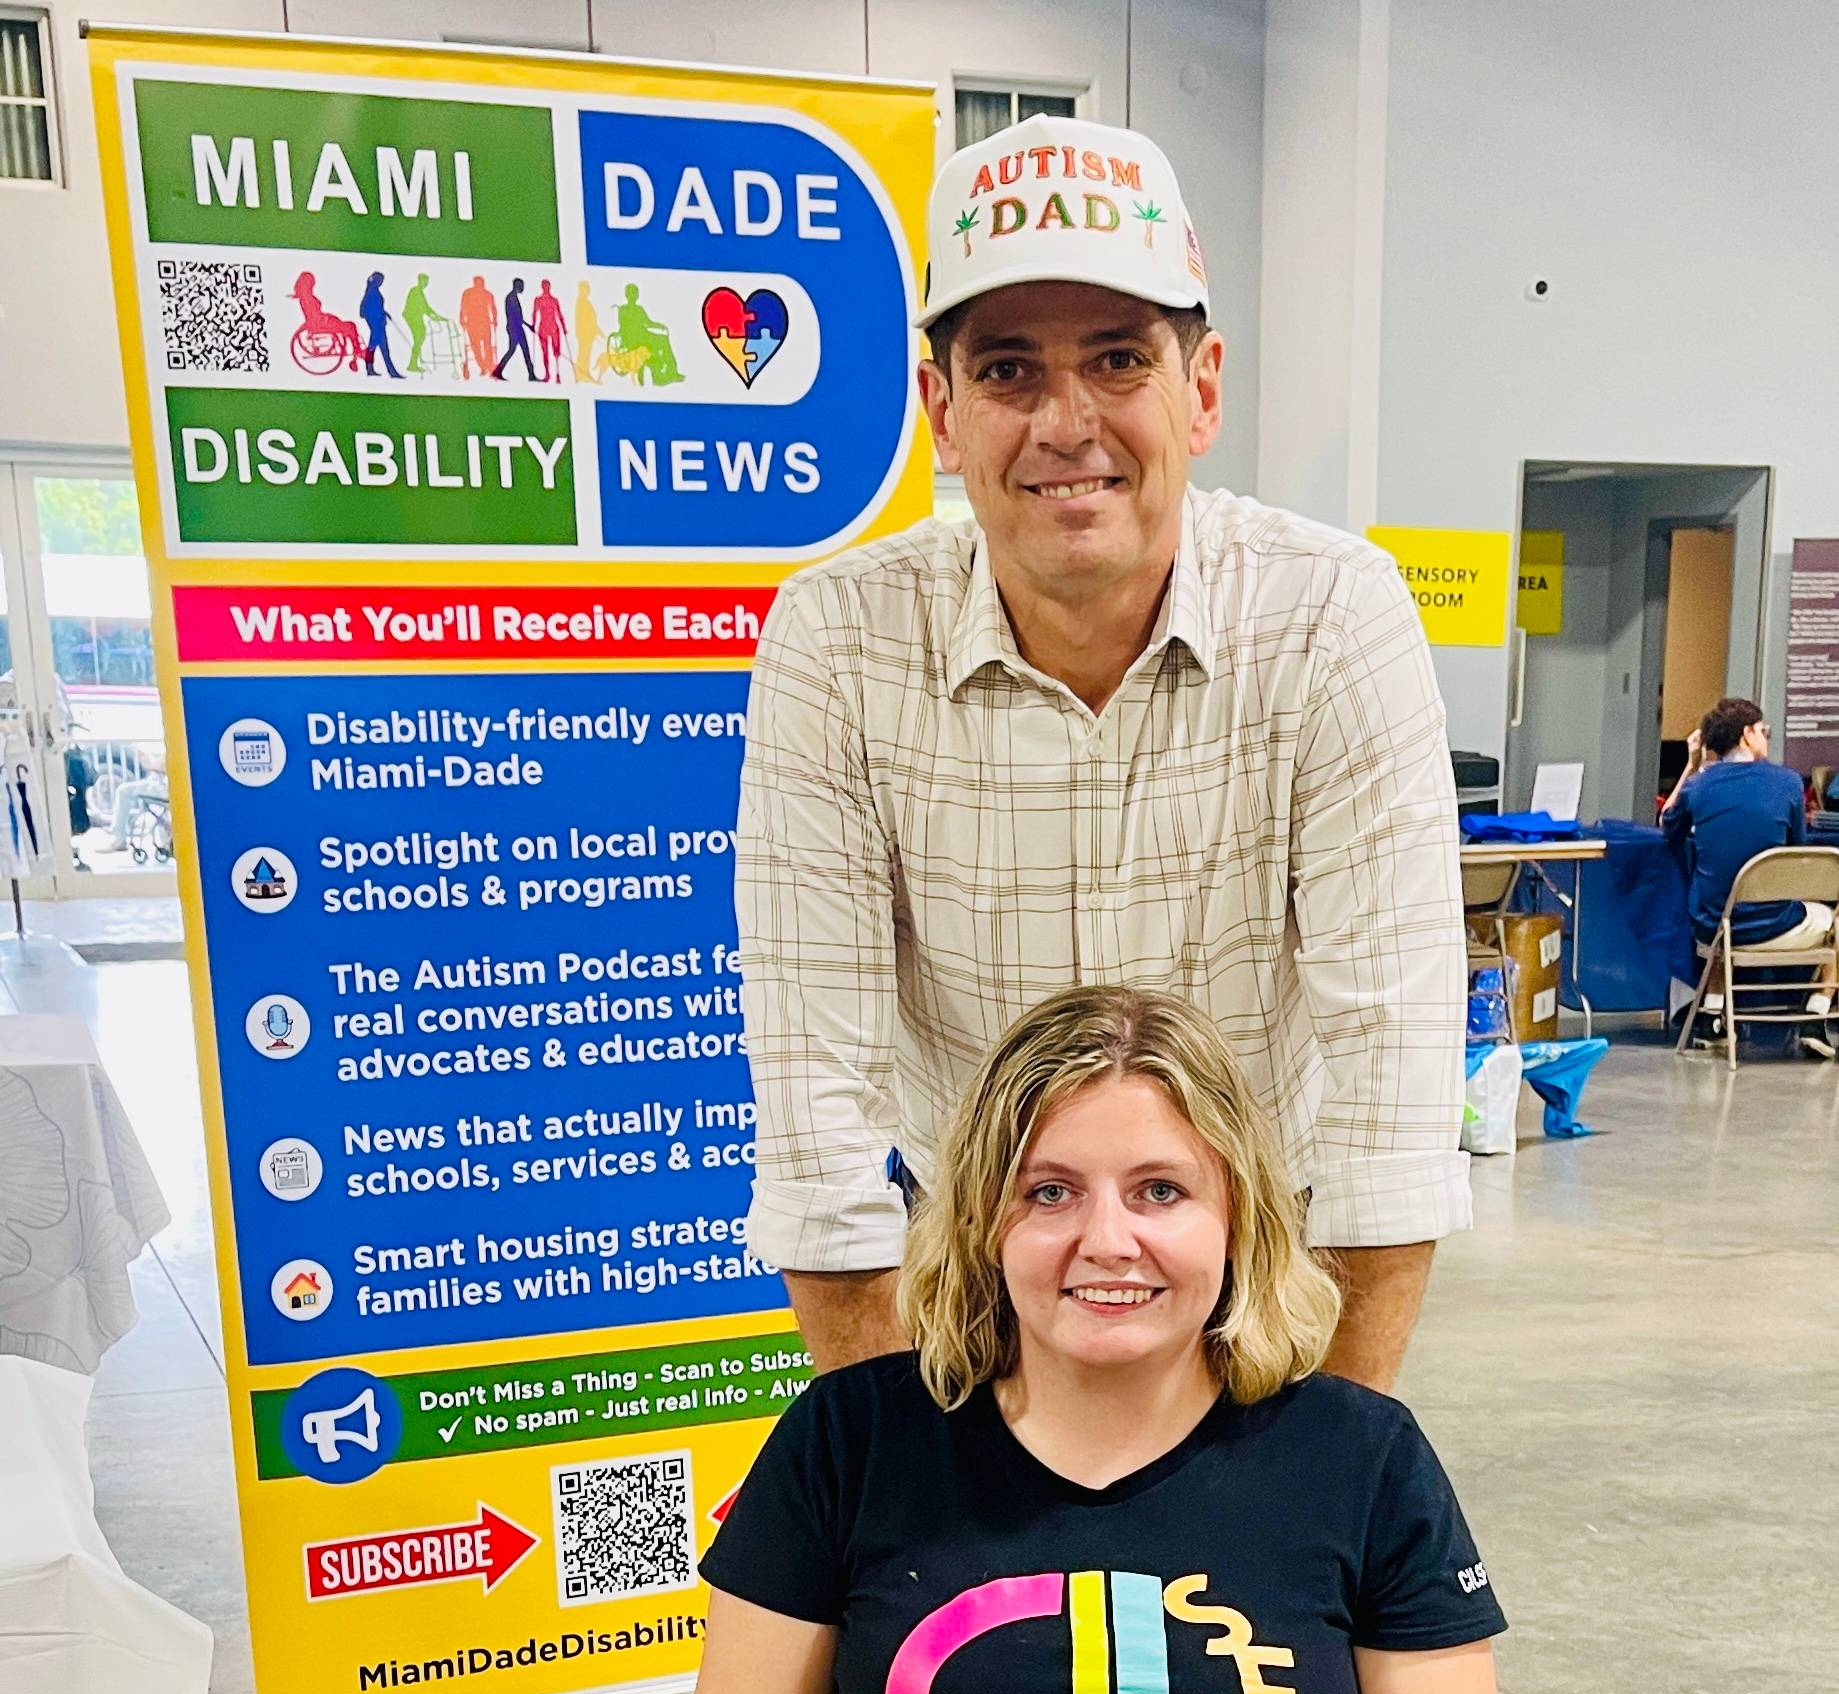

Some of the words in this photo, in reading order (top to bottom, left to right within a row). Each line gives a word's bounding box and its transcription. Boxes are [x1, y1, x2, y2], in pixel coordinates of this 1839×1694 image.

[190, 133, 474, 221] MIAMI
[603, 162, 842, 241] DADE
[969, 145, 1143, 198] AUTISM
[988, 192, 1121, 239] DAD
[181, 427, 568, 490] DISABILITY
[618, 439, 821, 493] NEWS
[230, 605, 353, 643] What
[361, 605, 481, 642] You'll
[493, 605, 653, 641] Receive
[662, 604, 760, 640] Each
[306, 707, 652, 749] Disability-friendly
[311, 753, 544, 791] Miami-Dade
[319, 830, 500, 874] Spotlight
[511, 837, 559, 861] on
[570, 825, 657, 860] local
[323, 876, 470, 914] schools
[481, 875, 507, 906] &
[519, 873, 693, 911] programs
[328, 961, 400, 996] The
[413, 955, 546, 991] Autism
[558, 948, 702, 983] Podcast
[333, 1002, 404, 1038] real
[418, 992, 673, 1033] conversations
[337, 1043, 532, 1082] advocates
[542, 1038, 567, 1068] &
[344, 1124, 445, 1156] News
[456, 1114, 532, 1146] that
[543, 1101, 683, 1141] actually
[346, 1158, 500, 1198] schools,
[512, 1147, 657, 1185] services
[667, 1141, 691, 1171] &
[354, 1236, 466, 1276] Smart
[477, 1225, 619, 1270] housing
[356, 1276, 502, 1317] families
[513, 1266, 591, 1300] with
[419, 1384, 487, 1411] Don't
[493, 1379, 545, 1403] Miss
[551, 1380, 565, 1396] a
[571, 1369, 637, 1396] Thing
[660, 1362, 714, 1384] Scan
[719, 1358, 744, 1376] to
[474, 1414, 509, 1436] No
[516, 1407, 580, 1437] spam
[601, 1396, 650, 1421] Just
[656, 1388, 698, 1414] real
[704, 1384, 748, 1407] Info
[320, 1528, 494, 1590] SUBSCRIBE
